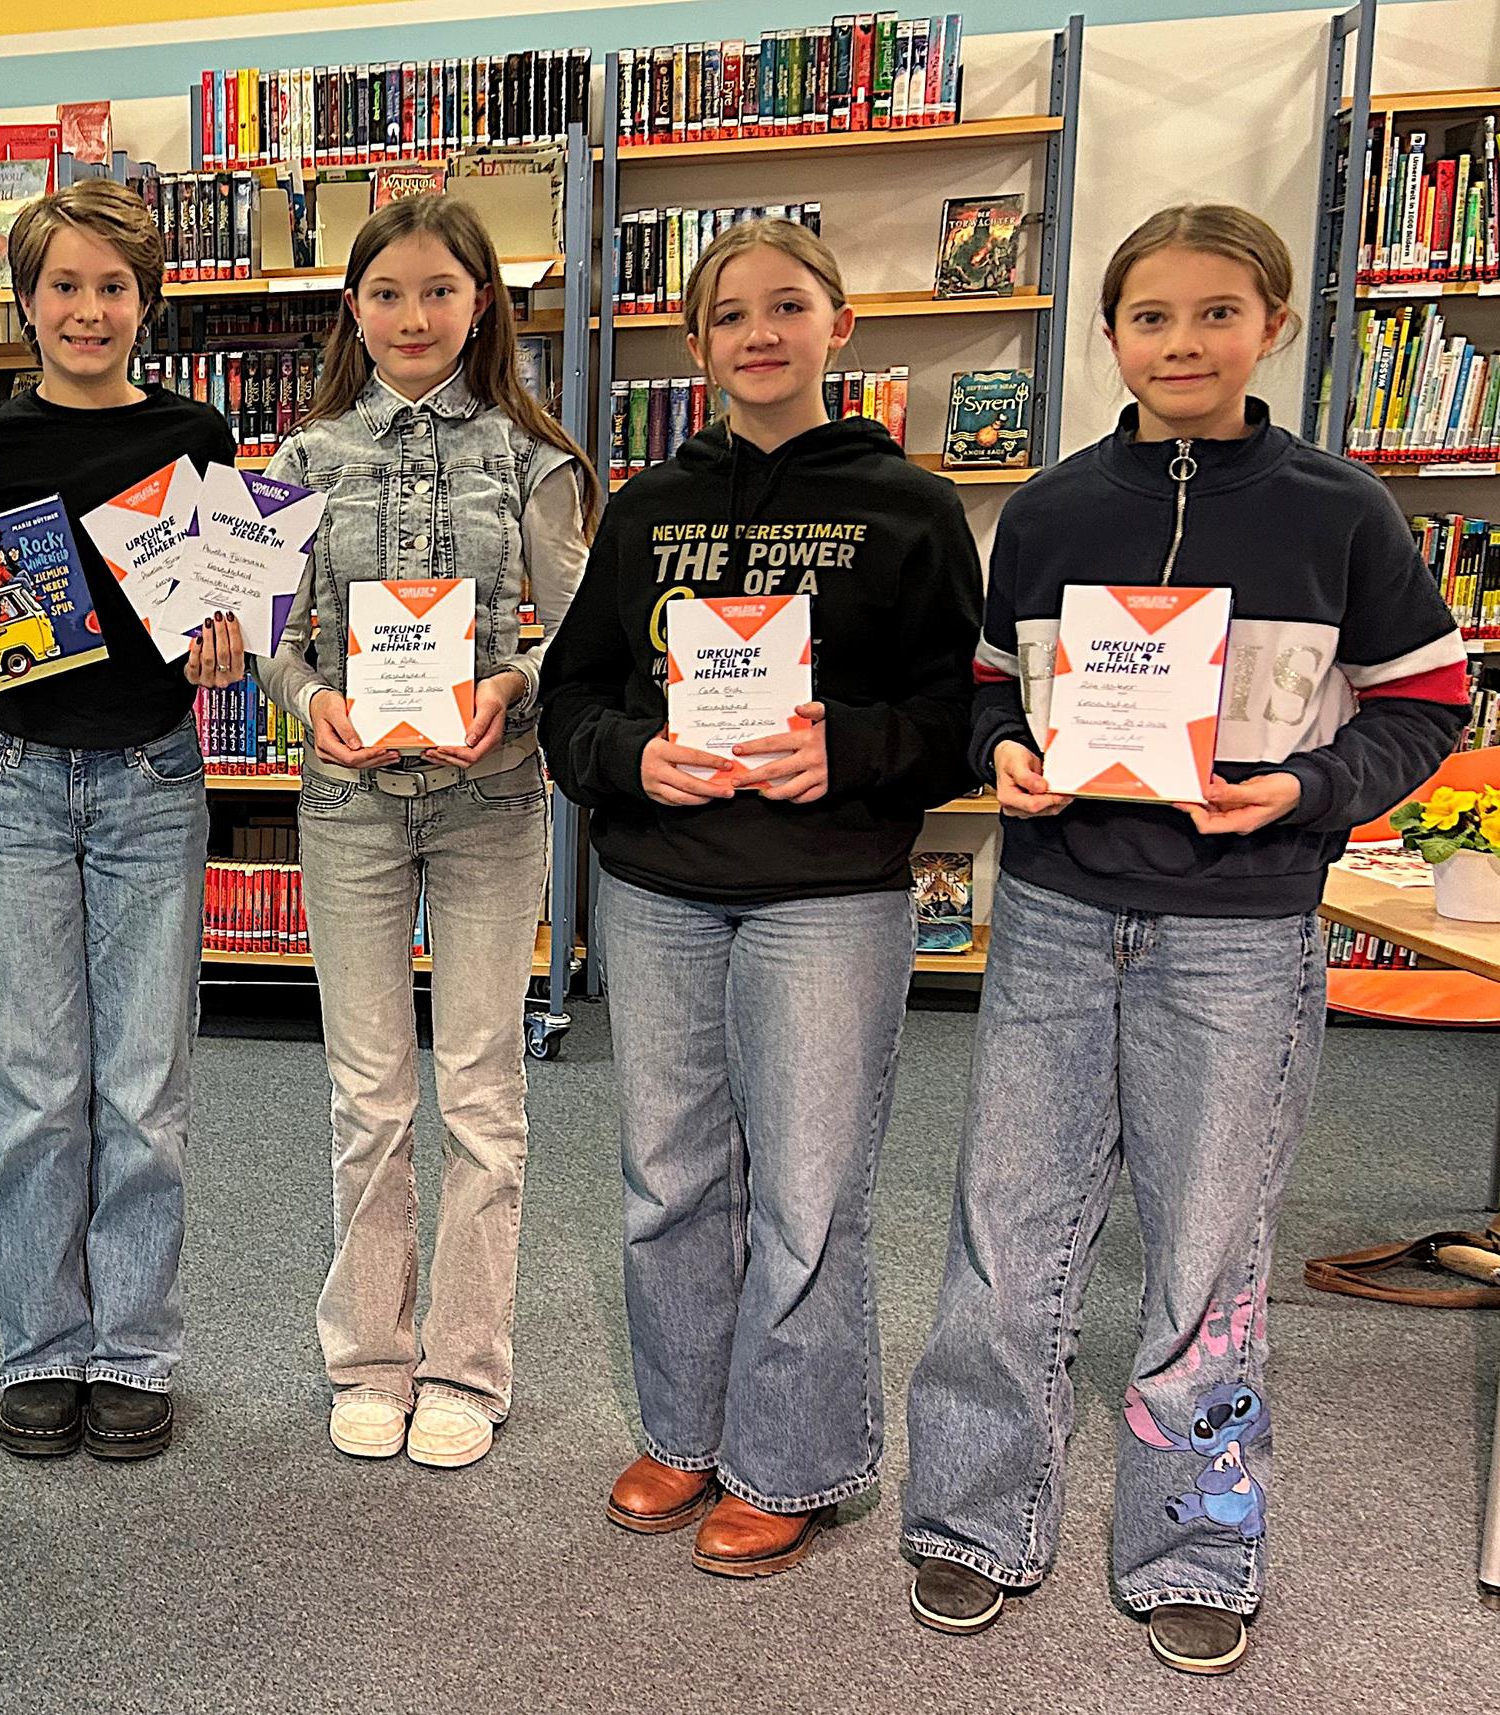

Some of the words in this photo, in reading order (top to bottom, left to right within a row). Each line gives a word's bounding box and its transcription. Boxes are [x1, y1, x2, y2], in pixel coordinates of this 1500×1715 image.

[964, 395, 1016, 415] Syren
[211, 511, 264, 534] URKUNDE
[126, 516, 176, 551] URKUNDE
[652, 525, 706, 541] NEVER
[141, 537, 163, 553] TEIL
[23, 549, 69, 572] WINTERFELD
[653, 542, 729, 583] THE
[748, 542, 856, 569] POWER
[34, 565, 69, 583] ZIEMLICH
[744, 569, 786, 595] OF
[796, 570, 819, 595] A
[42, 578, 68, 593] NEBEN
[51, 591, 66, 602] DER
[51, 601, 75, 617] SPUR
[374, 624, 431, 634] URKUNDE
[388, 634, 410, 643] TEIL
[1091, 640, 1167, 653] URKUNDE
[697, 648, 761, 660] URKUNDE
[1108, 652, 1135, 662] TEIL
[713, 659, 737, 668] TEIL
